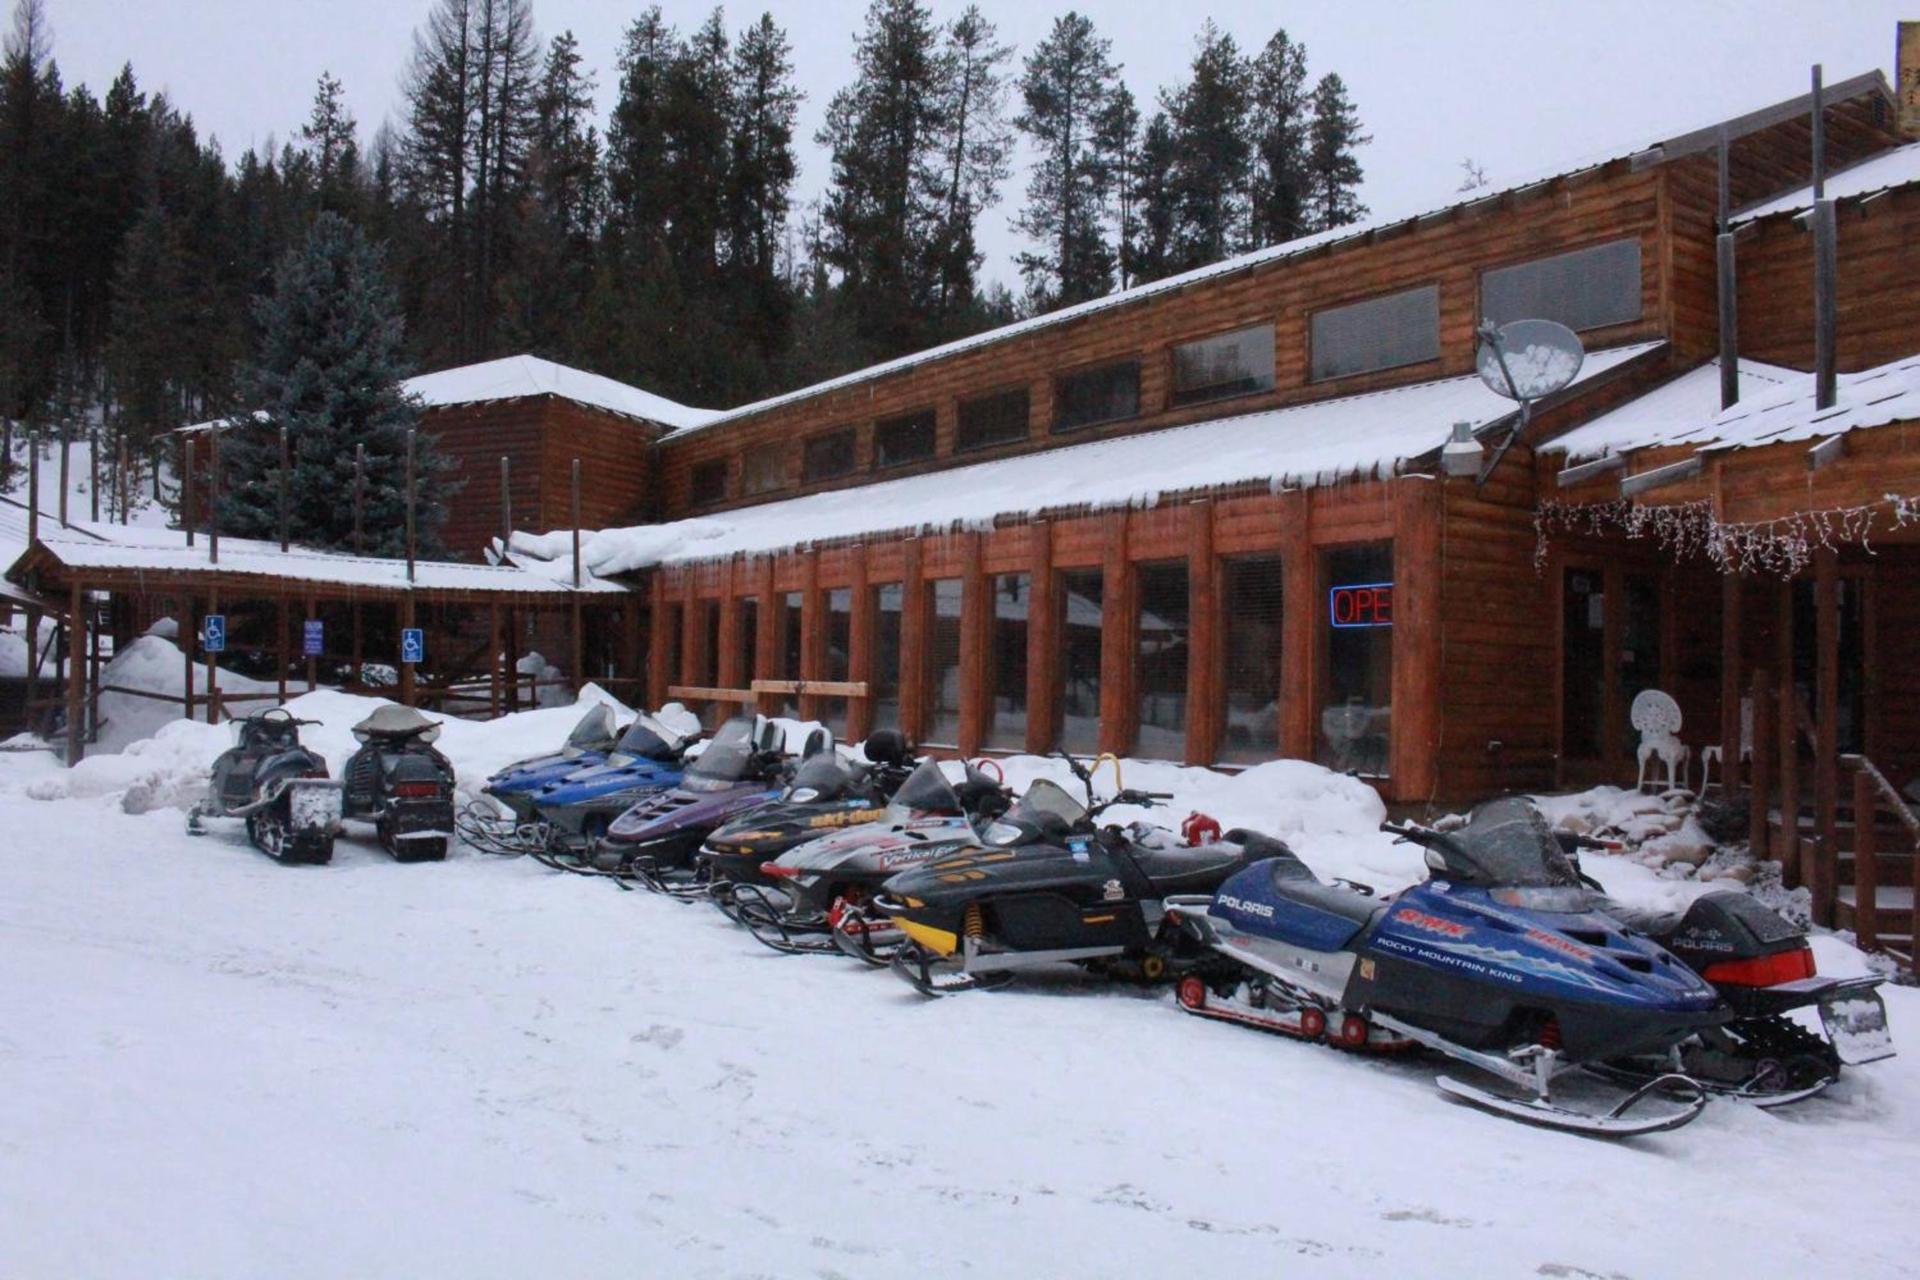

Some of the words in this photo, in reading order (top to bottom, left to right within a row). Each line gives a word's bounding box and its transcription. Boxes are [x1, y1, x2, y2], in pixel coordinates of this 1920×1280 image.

[1334, 588, 1393, 623] OPE
[1217, 894, 1276, 918] POLARIS
[1672, 937, 1735, 953] POLARIS
[1375, 937, 1416, 954] ROCKY
[1417, 948, 1486, 974] MOUNTAIN
[1488, 968, 1524, 984] KING
